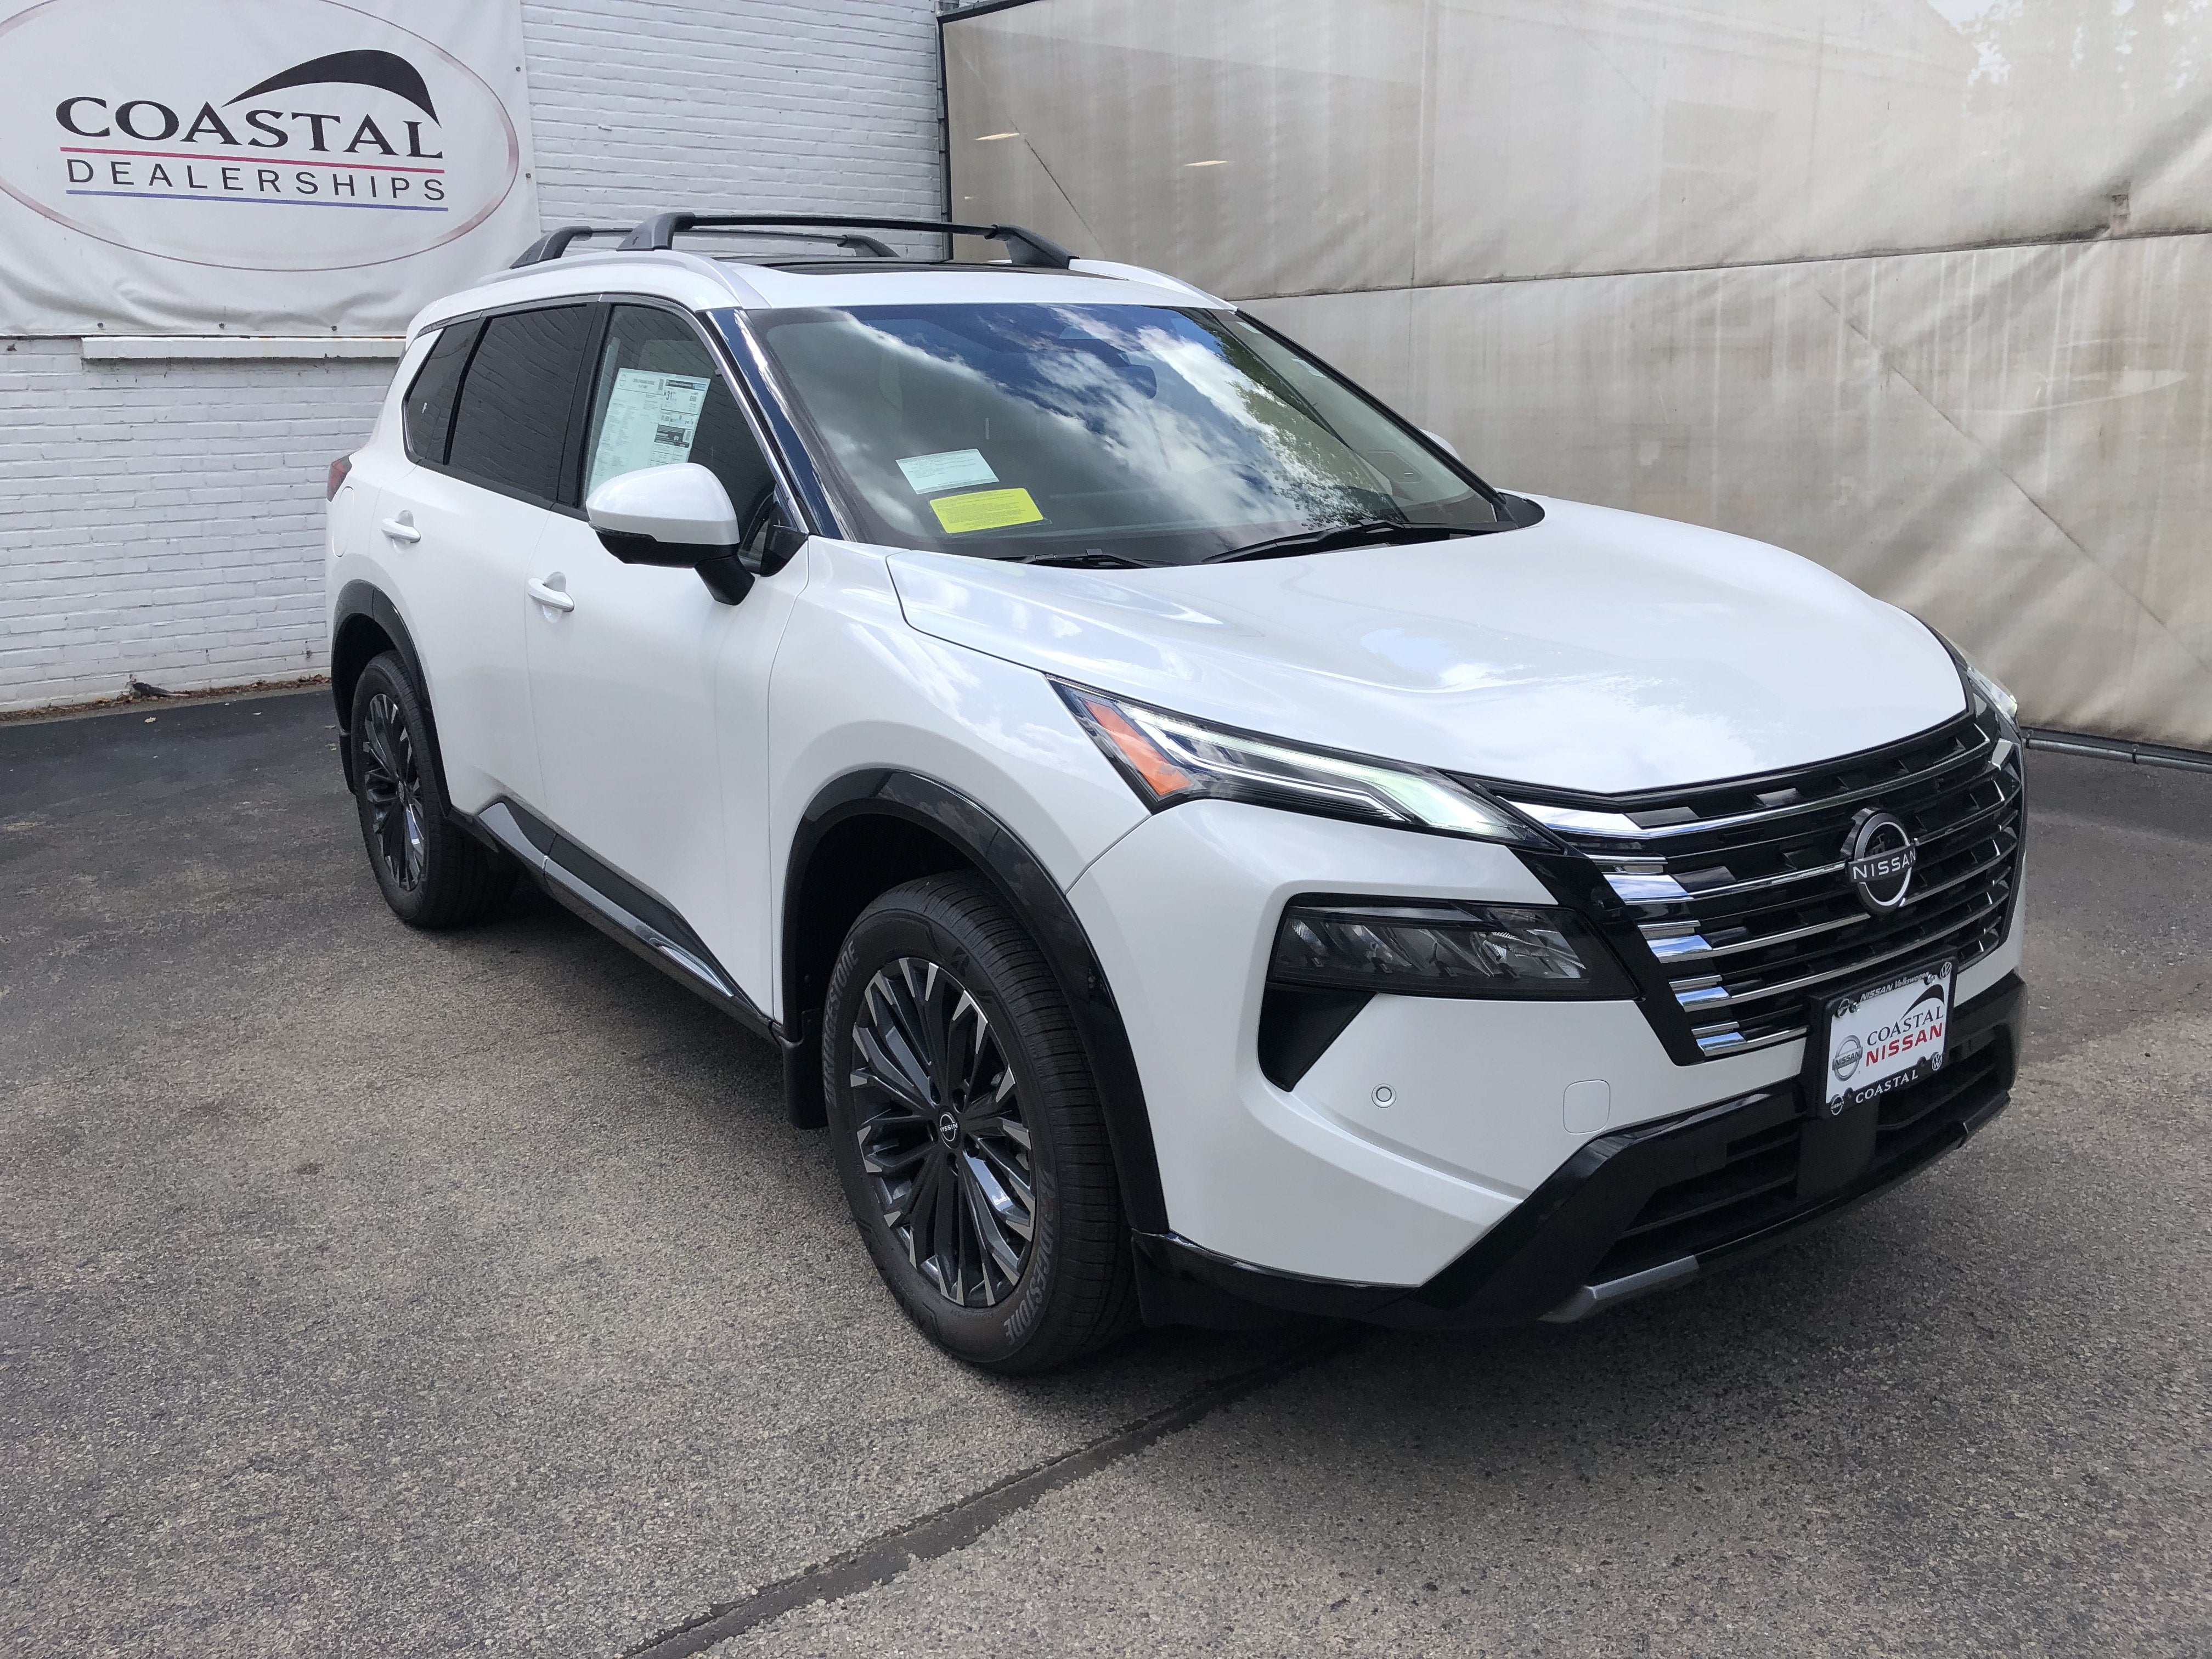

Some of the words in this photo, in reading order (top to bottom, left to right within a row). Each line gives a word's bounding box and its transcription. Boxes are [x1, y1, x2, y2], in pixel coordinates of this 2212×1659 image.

[55, 97, 443, 159] COASTAL
[67, 159, 445, 201] DEALERSHIPS
[1853, 848, 1916, 879] NISSAN
[1860, 983, 1893, 1002] NISSAN
[822, 939, 859, 1107] BRIDGESTONE
[1867, 1006, 1944, 1046] COASTAL
[1835, 1051, 1860, 1066] NISSAN
[1866, 1023, 1943, 1066] NISSAN
[1855, 1070, 1918, 1104] COASTAL
[939, 1123, 958, 1132] NISSAN
[1003, 1169, 1056, 1346] BRIDGESTONE
